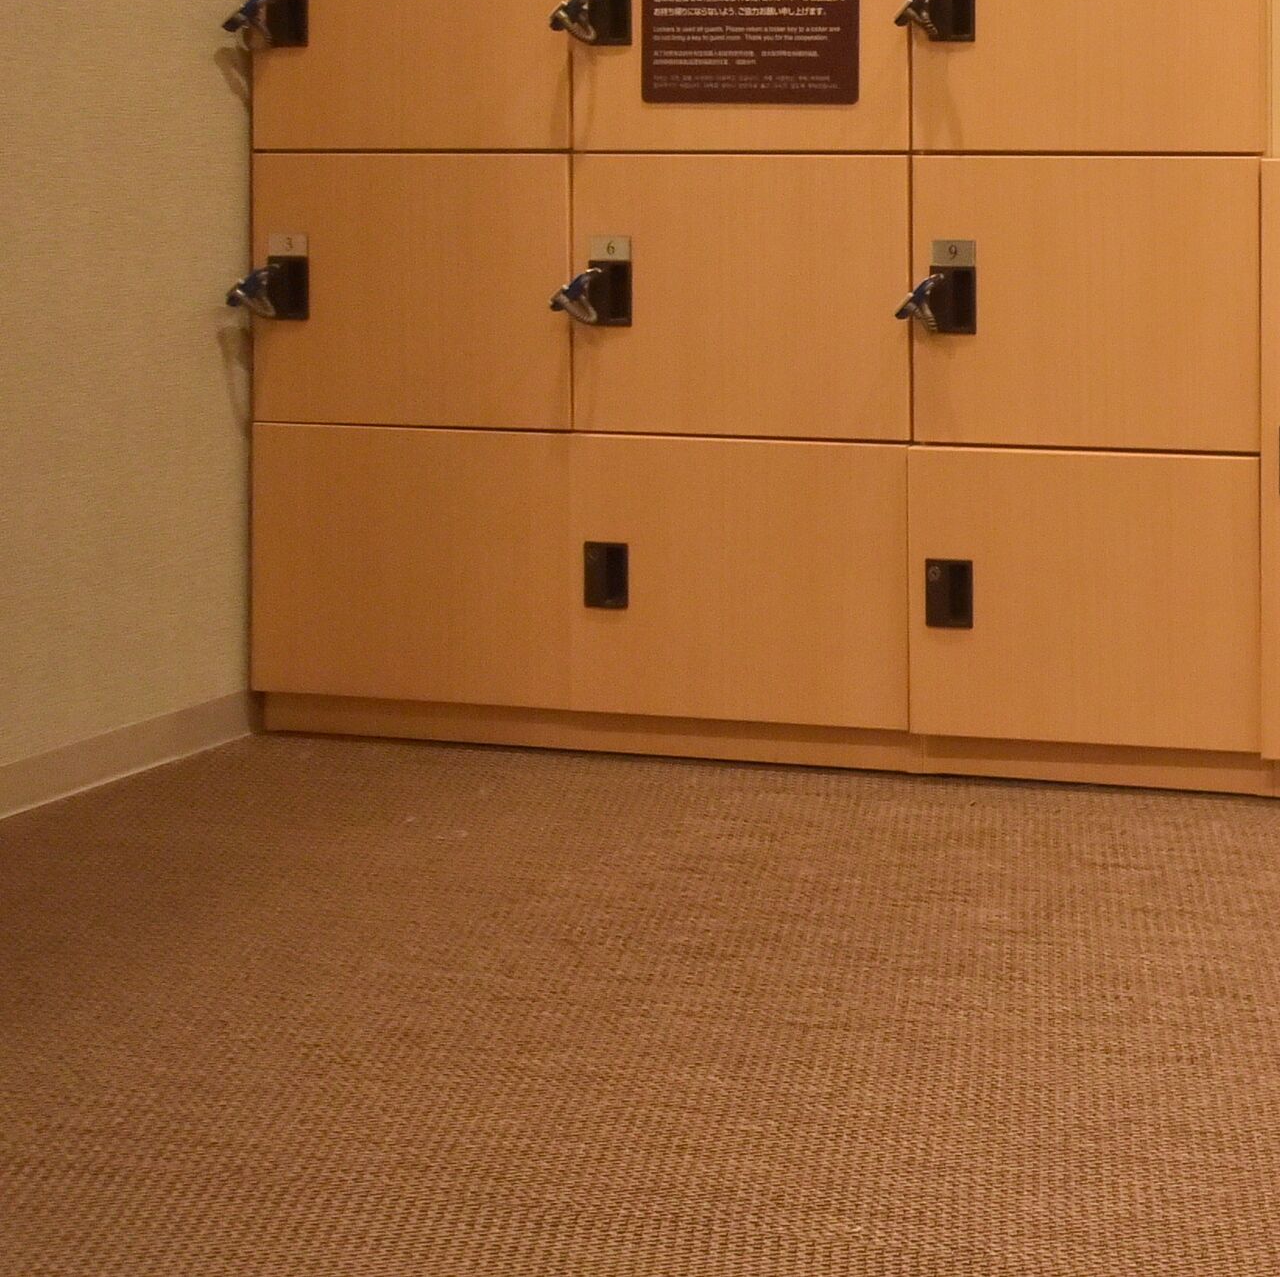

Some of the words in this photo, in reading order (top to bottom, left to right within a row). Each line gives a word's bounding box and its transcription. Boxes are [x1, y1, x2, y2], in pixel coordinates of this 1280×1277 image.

[286, 237, 293, 251] 3
[606, 241, 615, 255] 6
[948, 245, 957, 260] 9
